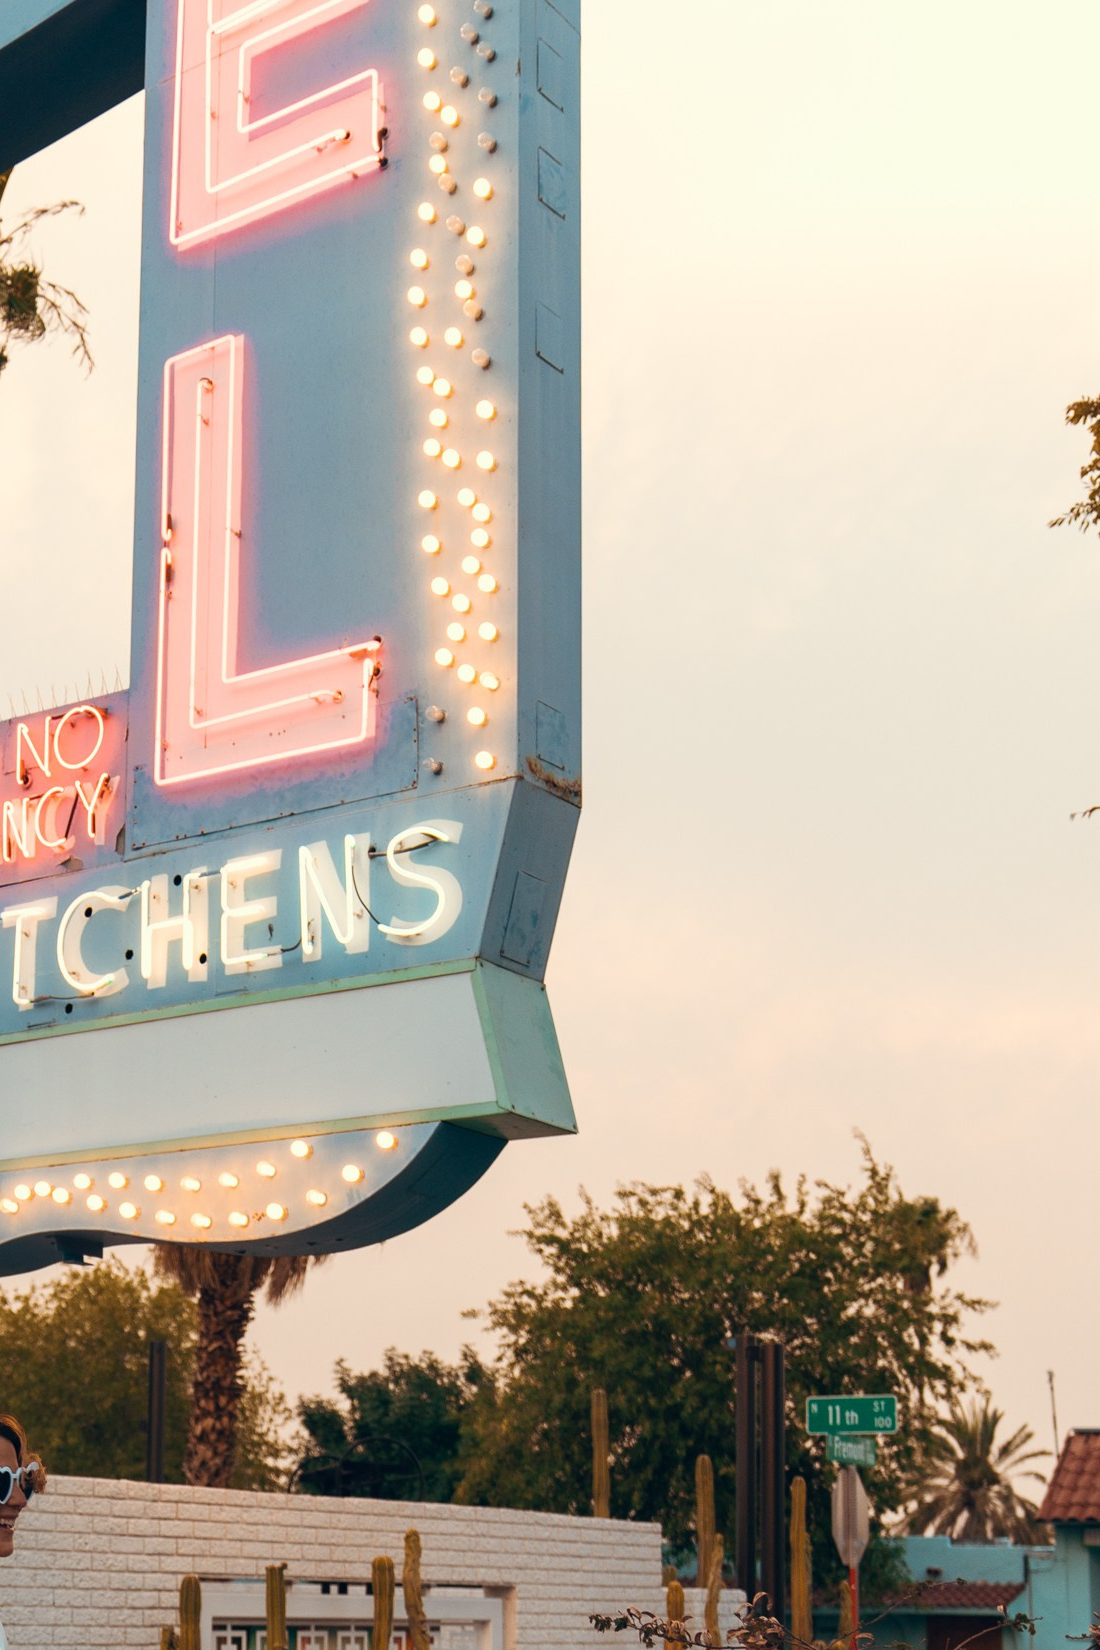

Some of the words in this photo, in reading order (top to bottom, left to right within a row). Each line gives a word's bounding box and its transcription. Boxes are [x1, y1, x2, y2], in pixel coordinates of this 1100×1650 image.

[16, 704, 106, 784] NO
[811, 1403, 818, 1413] N
[828, 1405, 859, 1426] 11th
[873, 1401, 886, 1413] ST
[874, 1417, 892, 1428] 100
